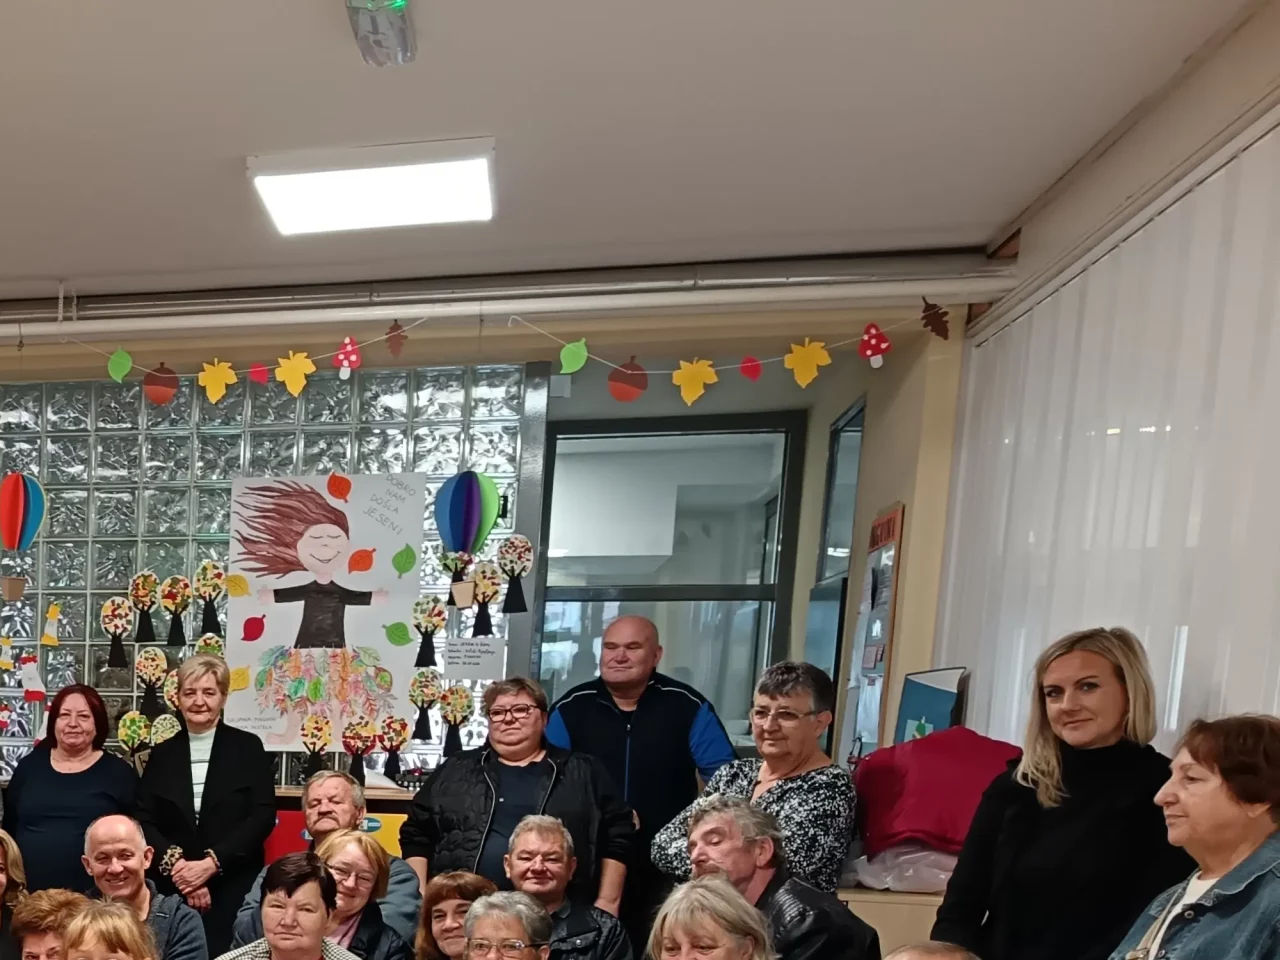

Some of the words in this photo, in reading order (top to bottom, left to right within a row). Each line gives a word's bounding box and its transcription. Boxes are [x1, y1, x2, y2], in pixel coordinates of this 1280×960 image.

[386, 473, 416, 497] DOBRO
[386, 488, 406, 503] NAM
[370, 493, 399, 515] DOŠLA
